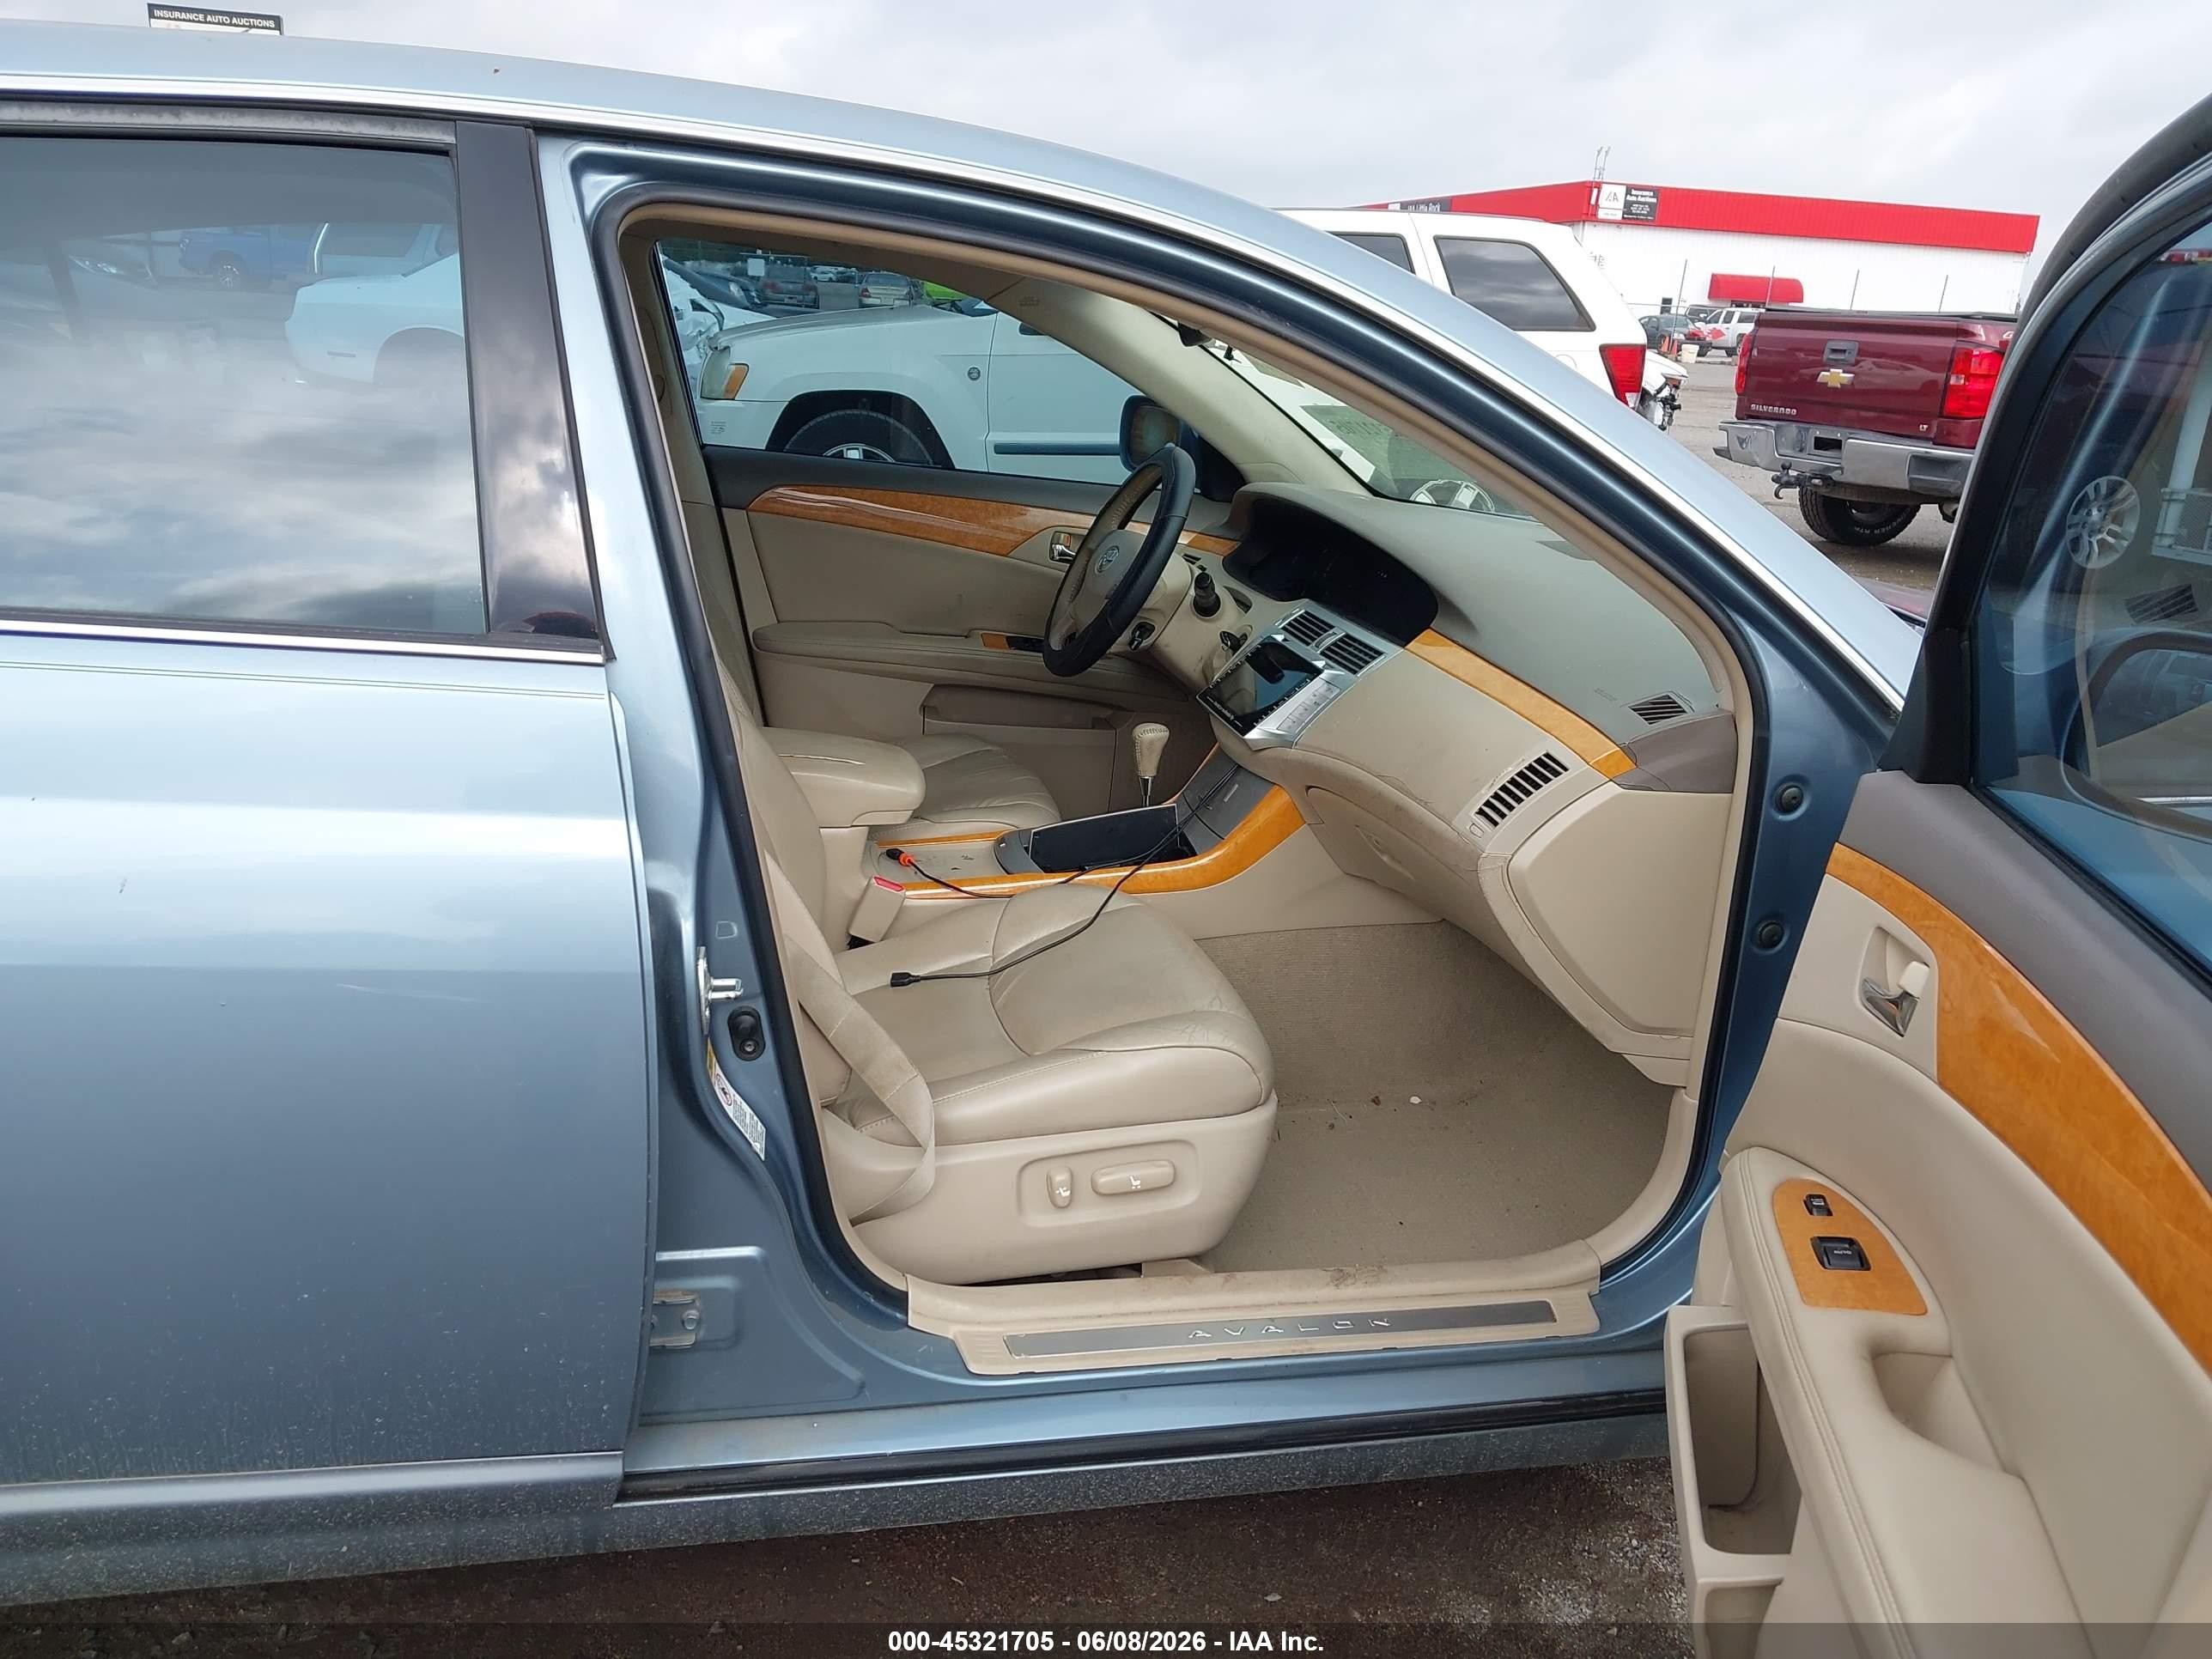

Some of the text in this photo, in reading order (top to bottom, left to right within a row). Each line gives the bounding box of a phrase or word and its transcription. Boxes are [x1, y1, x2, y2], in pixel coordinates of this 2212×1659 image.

[154, 9, 276, 27] INSURANCE AUTO AUCTIONS
[1751, 404, 1797, 416] SILVERADO
[1188, 1318, 1391, 1339] AVALON
